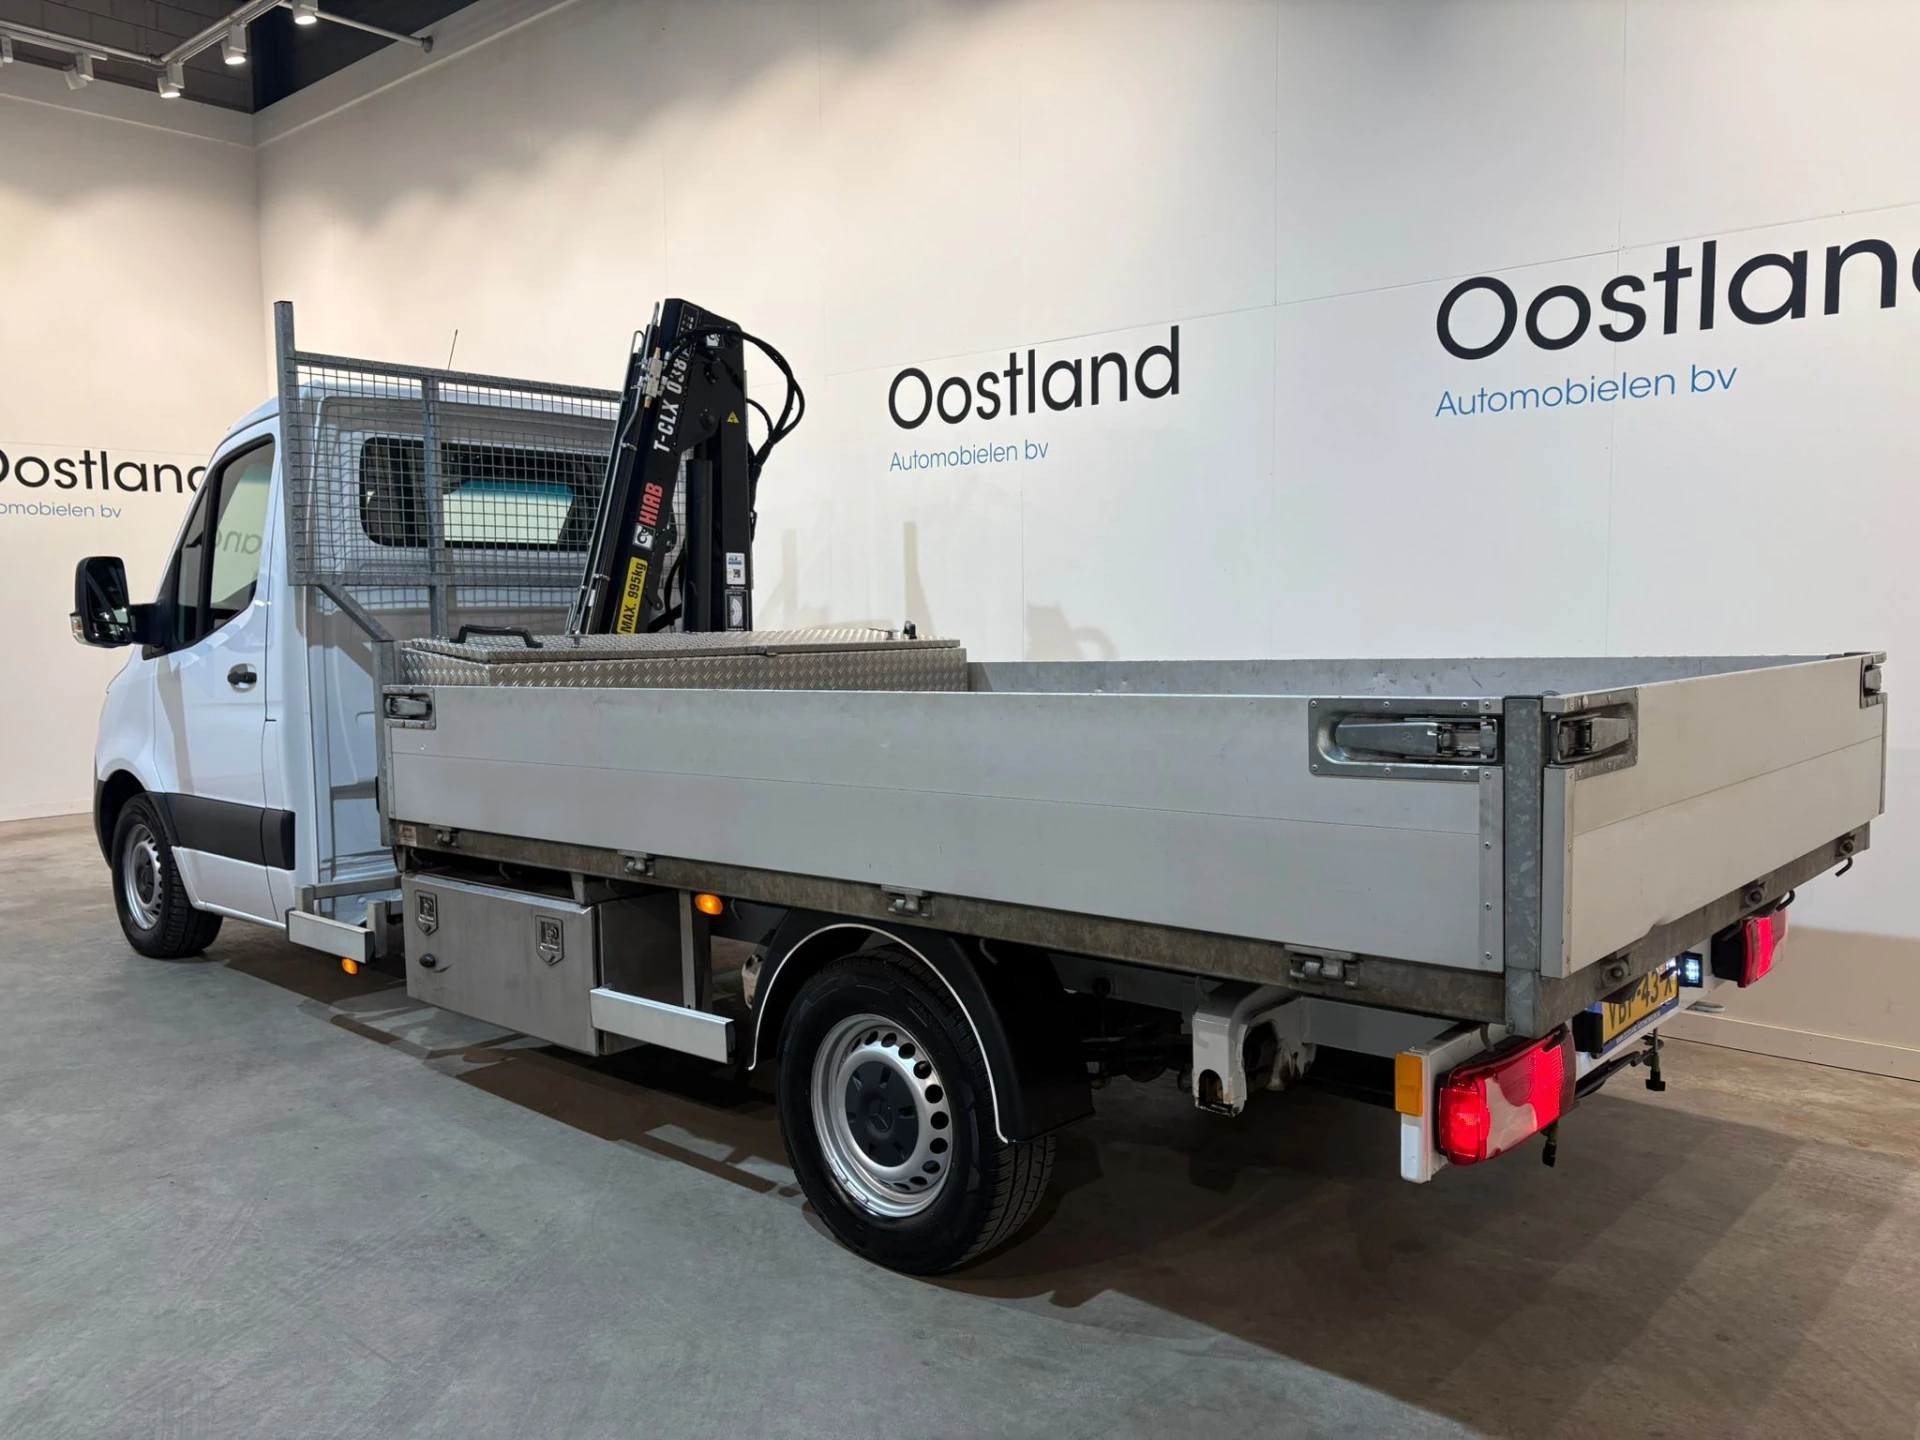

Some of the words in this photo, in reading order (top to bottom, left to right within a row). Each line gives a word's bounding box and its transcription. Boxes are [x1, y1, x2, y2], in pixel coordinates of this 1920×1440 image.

[1436, 239, 1920, 360] Oostlan
[888, 325, 1180, 430] Oostland
[1435, 371, 1676, 418] Automobielen
[1690, 363, 1738, 393] bv
[653, 398, 680, 453] T-CLX
[889, 442, 1018, 472] Automobielen
[1024, 439, 1049, 460] bv
[100, 504, 122, 519] bv
[638, 482, 663, 527] HIAB
[627, 562, 647, 599] 995kg
[621, 603, 636, 634] MAX.
